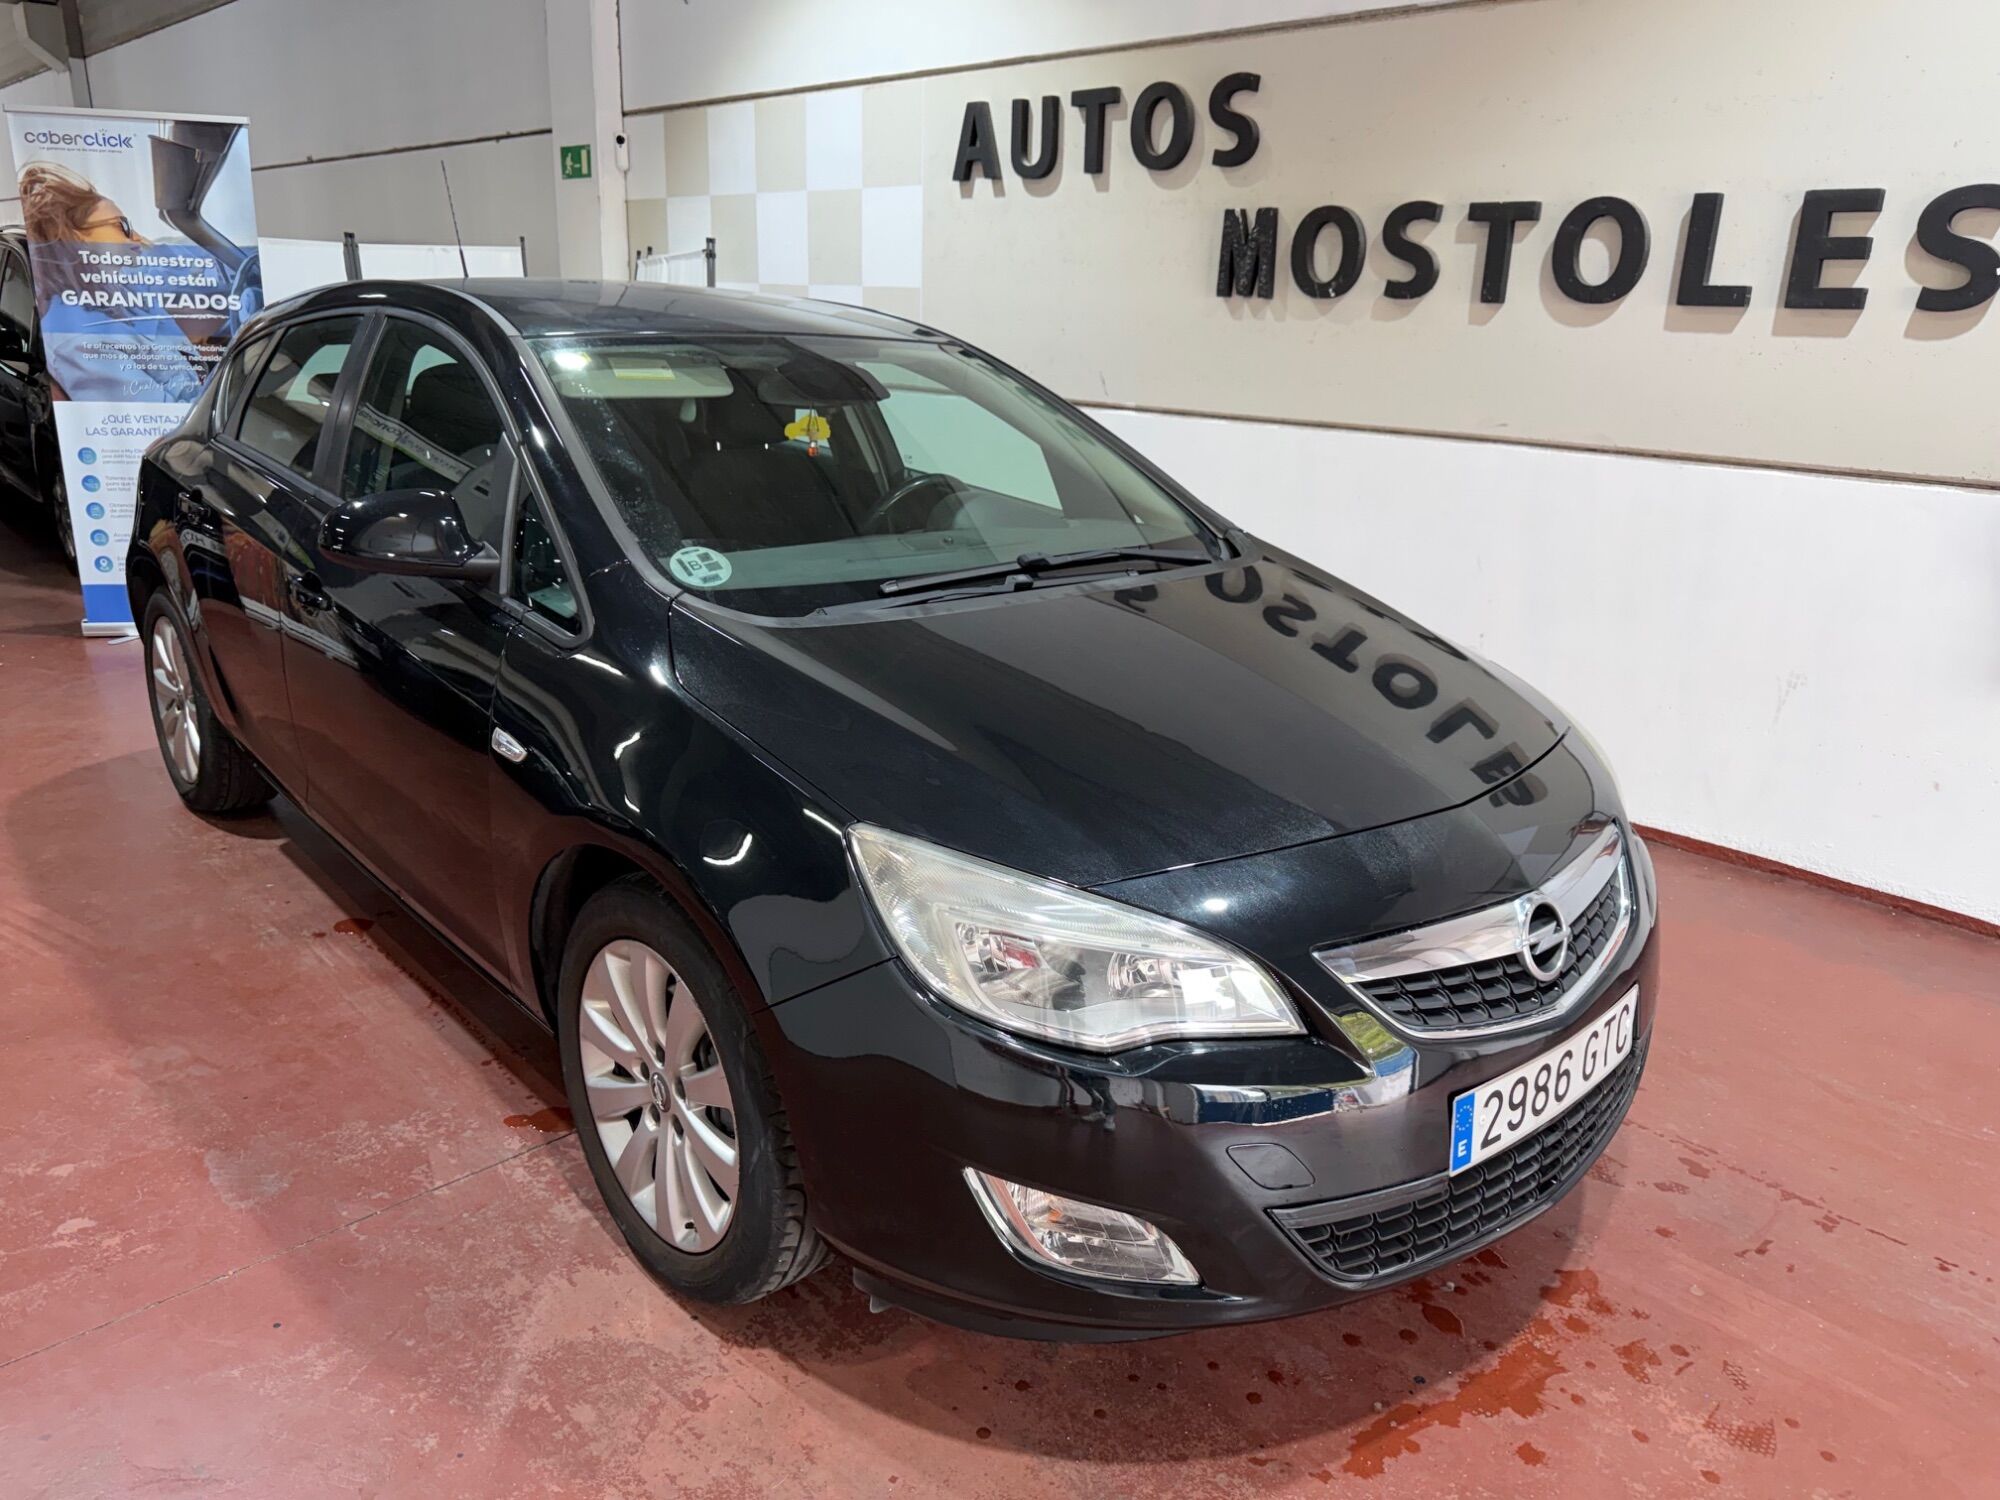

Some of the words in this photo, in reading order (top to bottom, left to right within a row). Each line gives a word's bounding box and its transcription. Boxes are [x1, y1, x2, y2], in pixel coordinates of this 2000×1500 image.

[953, 72, 1260, 182] AUTOS
[1216, 183, 2000, 312] MOSTOLES
[78, 250, 132, 266] Todos
[136, 254, 214, 269] nuestros
[80, 269, 164, 285] vehículos
[168, 273, 218, 287] están
[61, 289, 242, 311] GARANTIZADOS
[101, 413, 132, 425] ¿QUÉ
[85, 427, 108, 436] LAS
[687, 560, 703, 571] B
[1480, 1049, 1573, 1151] 2986
[1581, 1003, 1630, 1082] GTC
[1457, 1139, 1468, 1157] E
